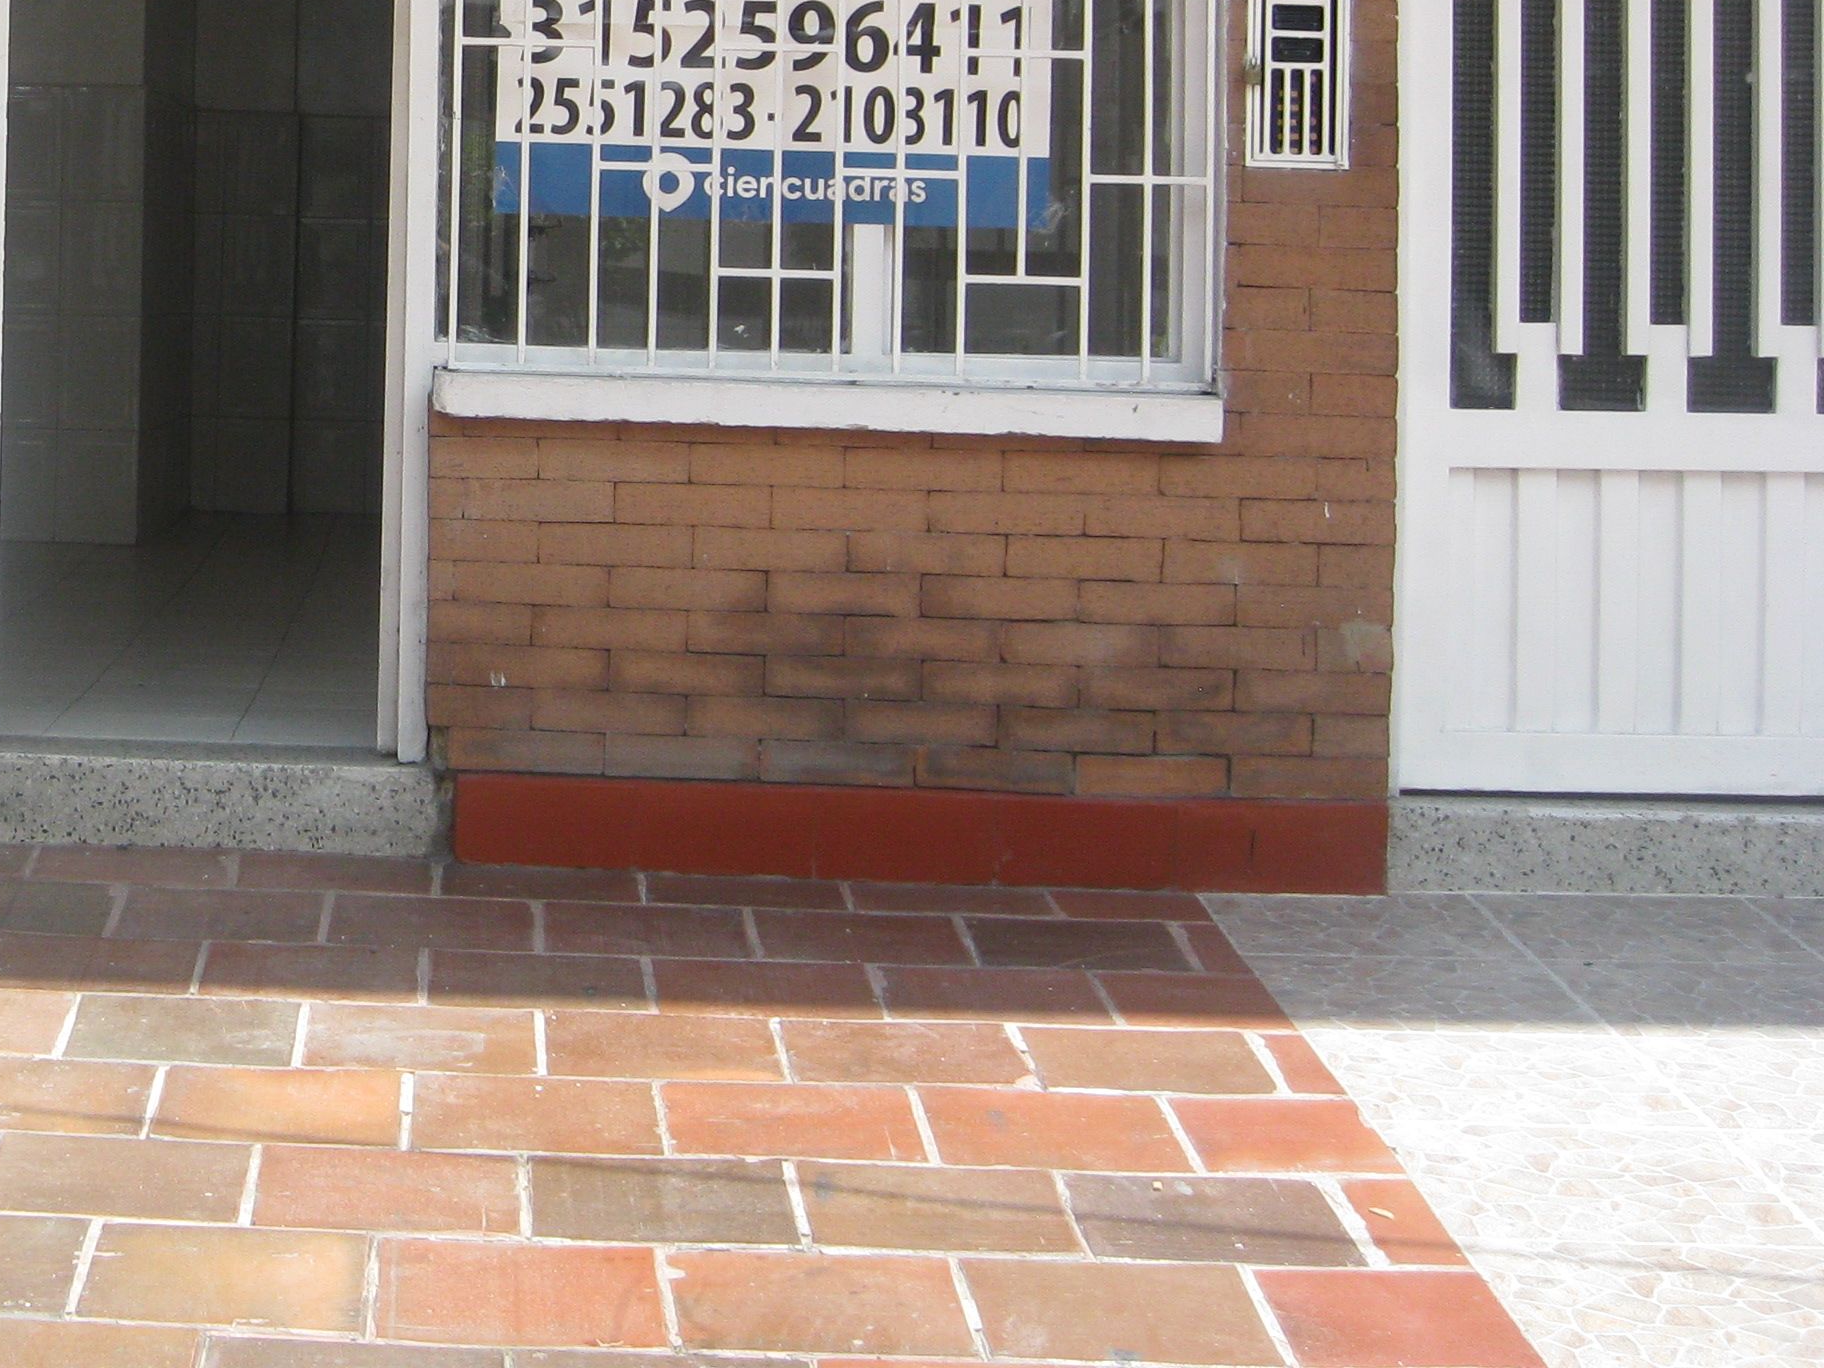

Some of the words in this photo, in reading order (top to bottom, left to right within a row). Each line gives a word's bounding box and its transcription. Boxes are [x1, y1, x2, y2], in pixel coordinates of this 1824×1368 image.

[514, 77, 756, 141] 2551283
[791, 82, 1022, 148] 2103110
[703, 166, 927, 203] ciencuadras
